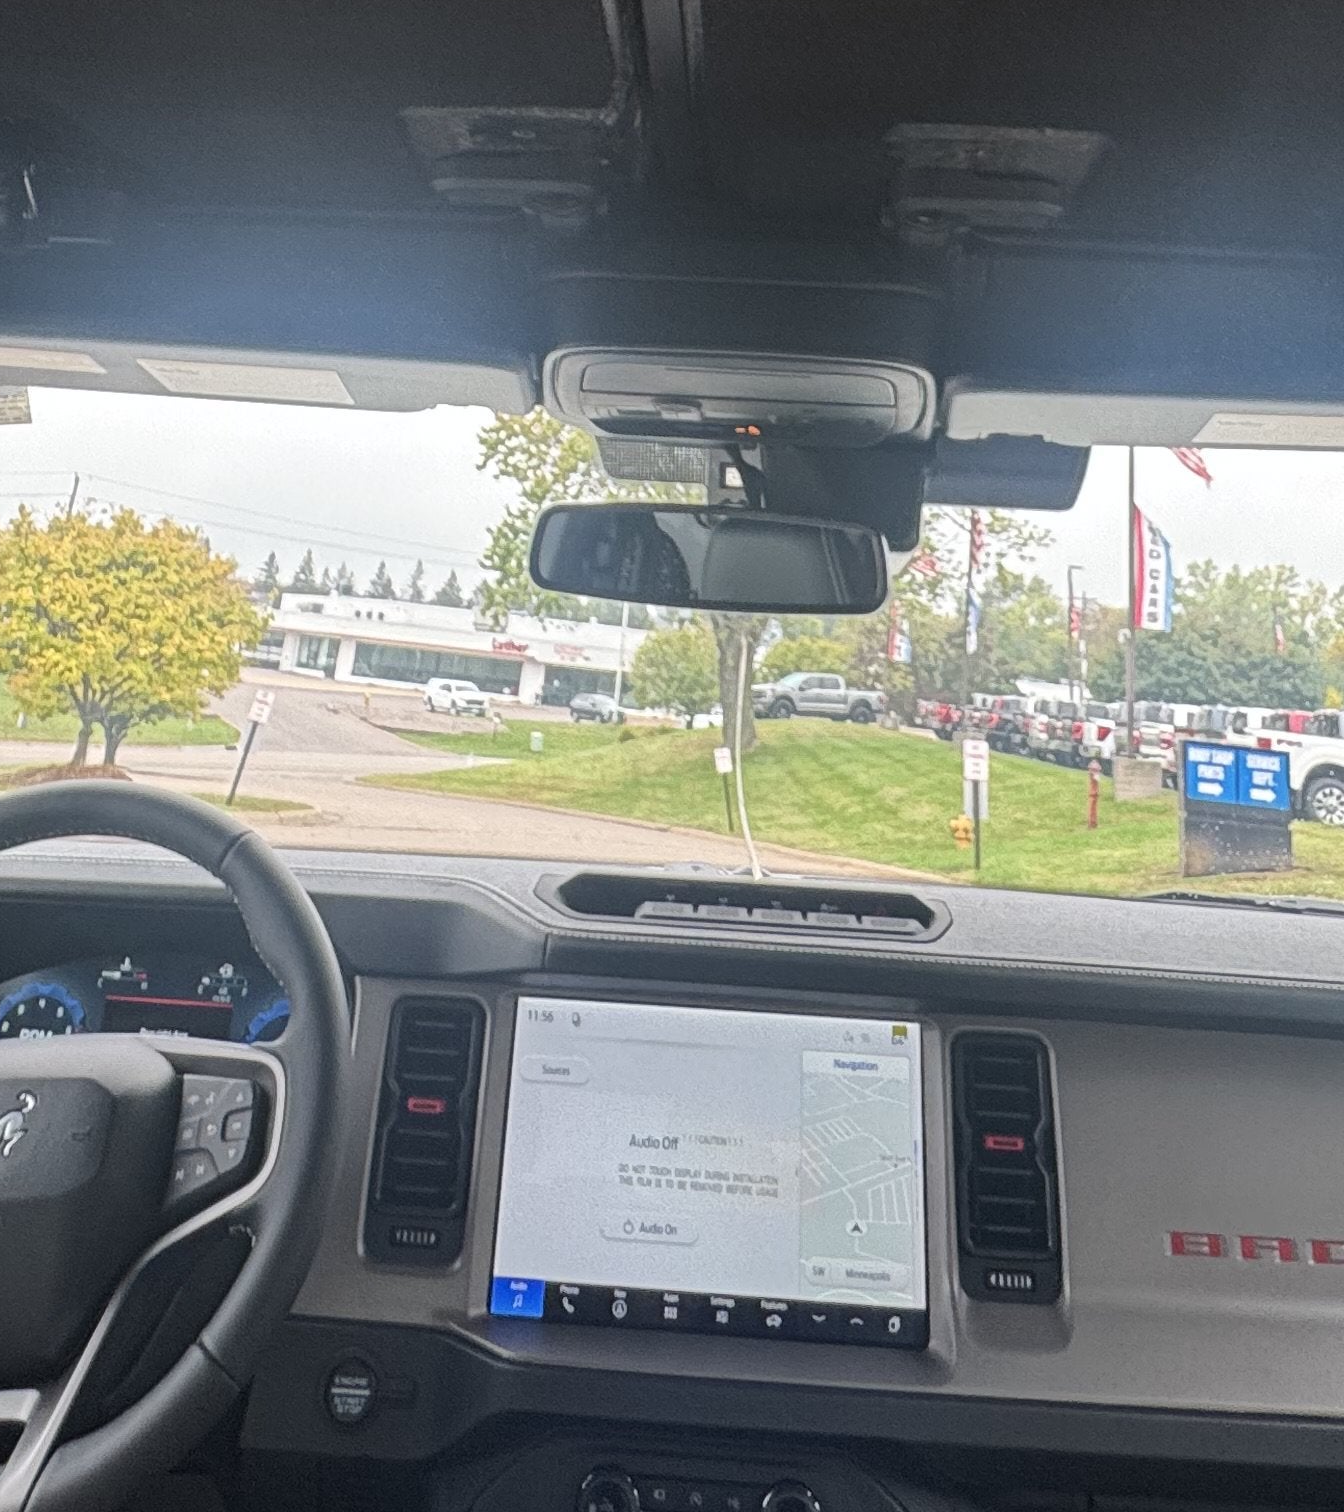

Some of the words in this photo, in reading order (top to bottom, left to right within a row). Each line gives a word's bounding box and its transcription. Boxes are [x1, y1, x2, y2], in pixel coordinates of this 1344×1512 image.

[833, 1058, 879, 1072] Navigation
[629, 1134, 661, 1150] Audio
[662, 1136, 679, 1150] Off
[639, 1221, 664, 1235] Audio
[664, 1223, 678, 1236] On
